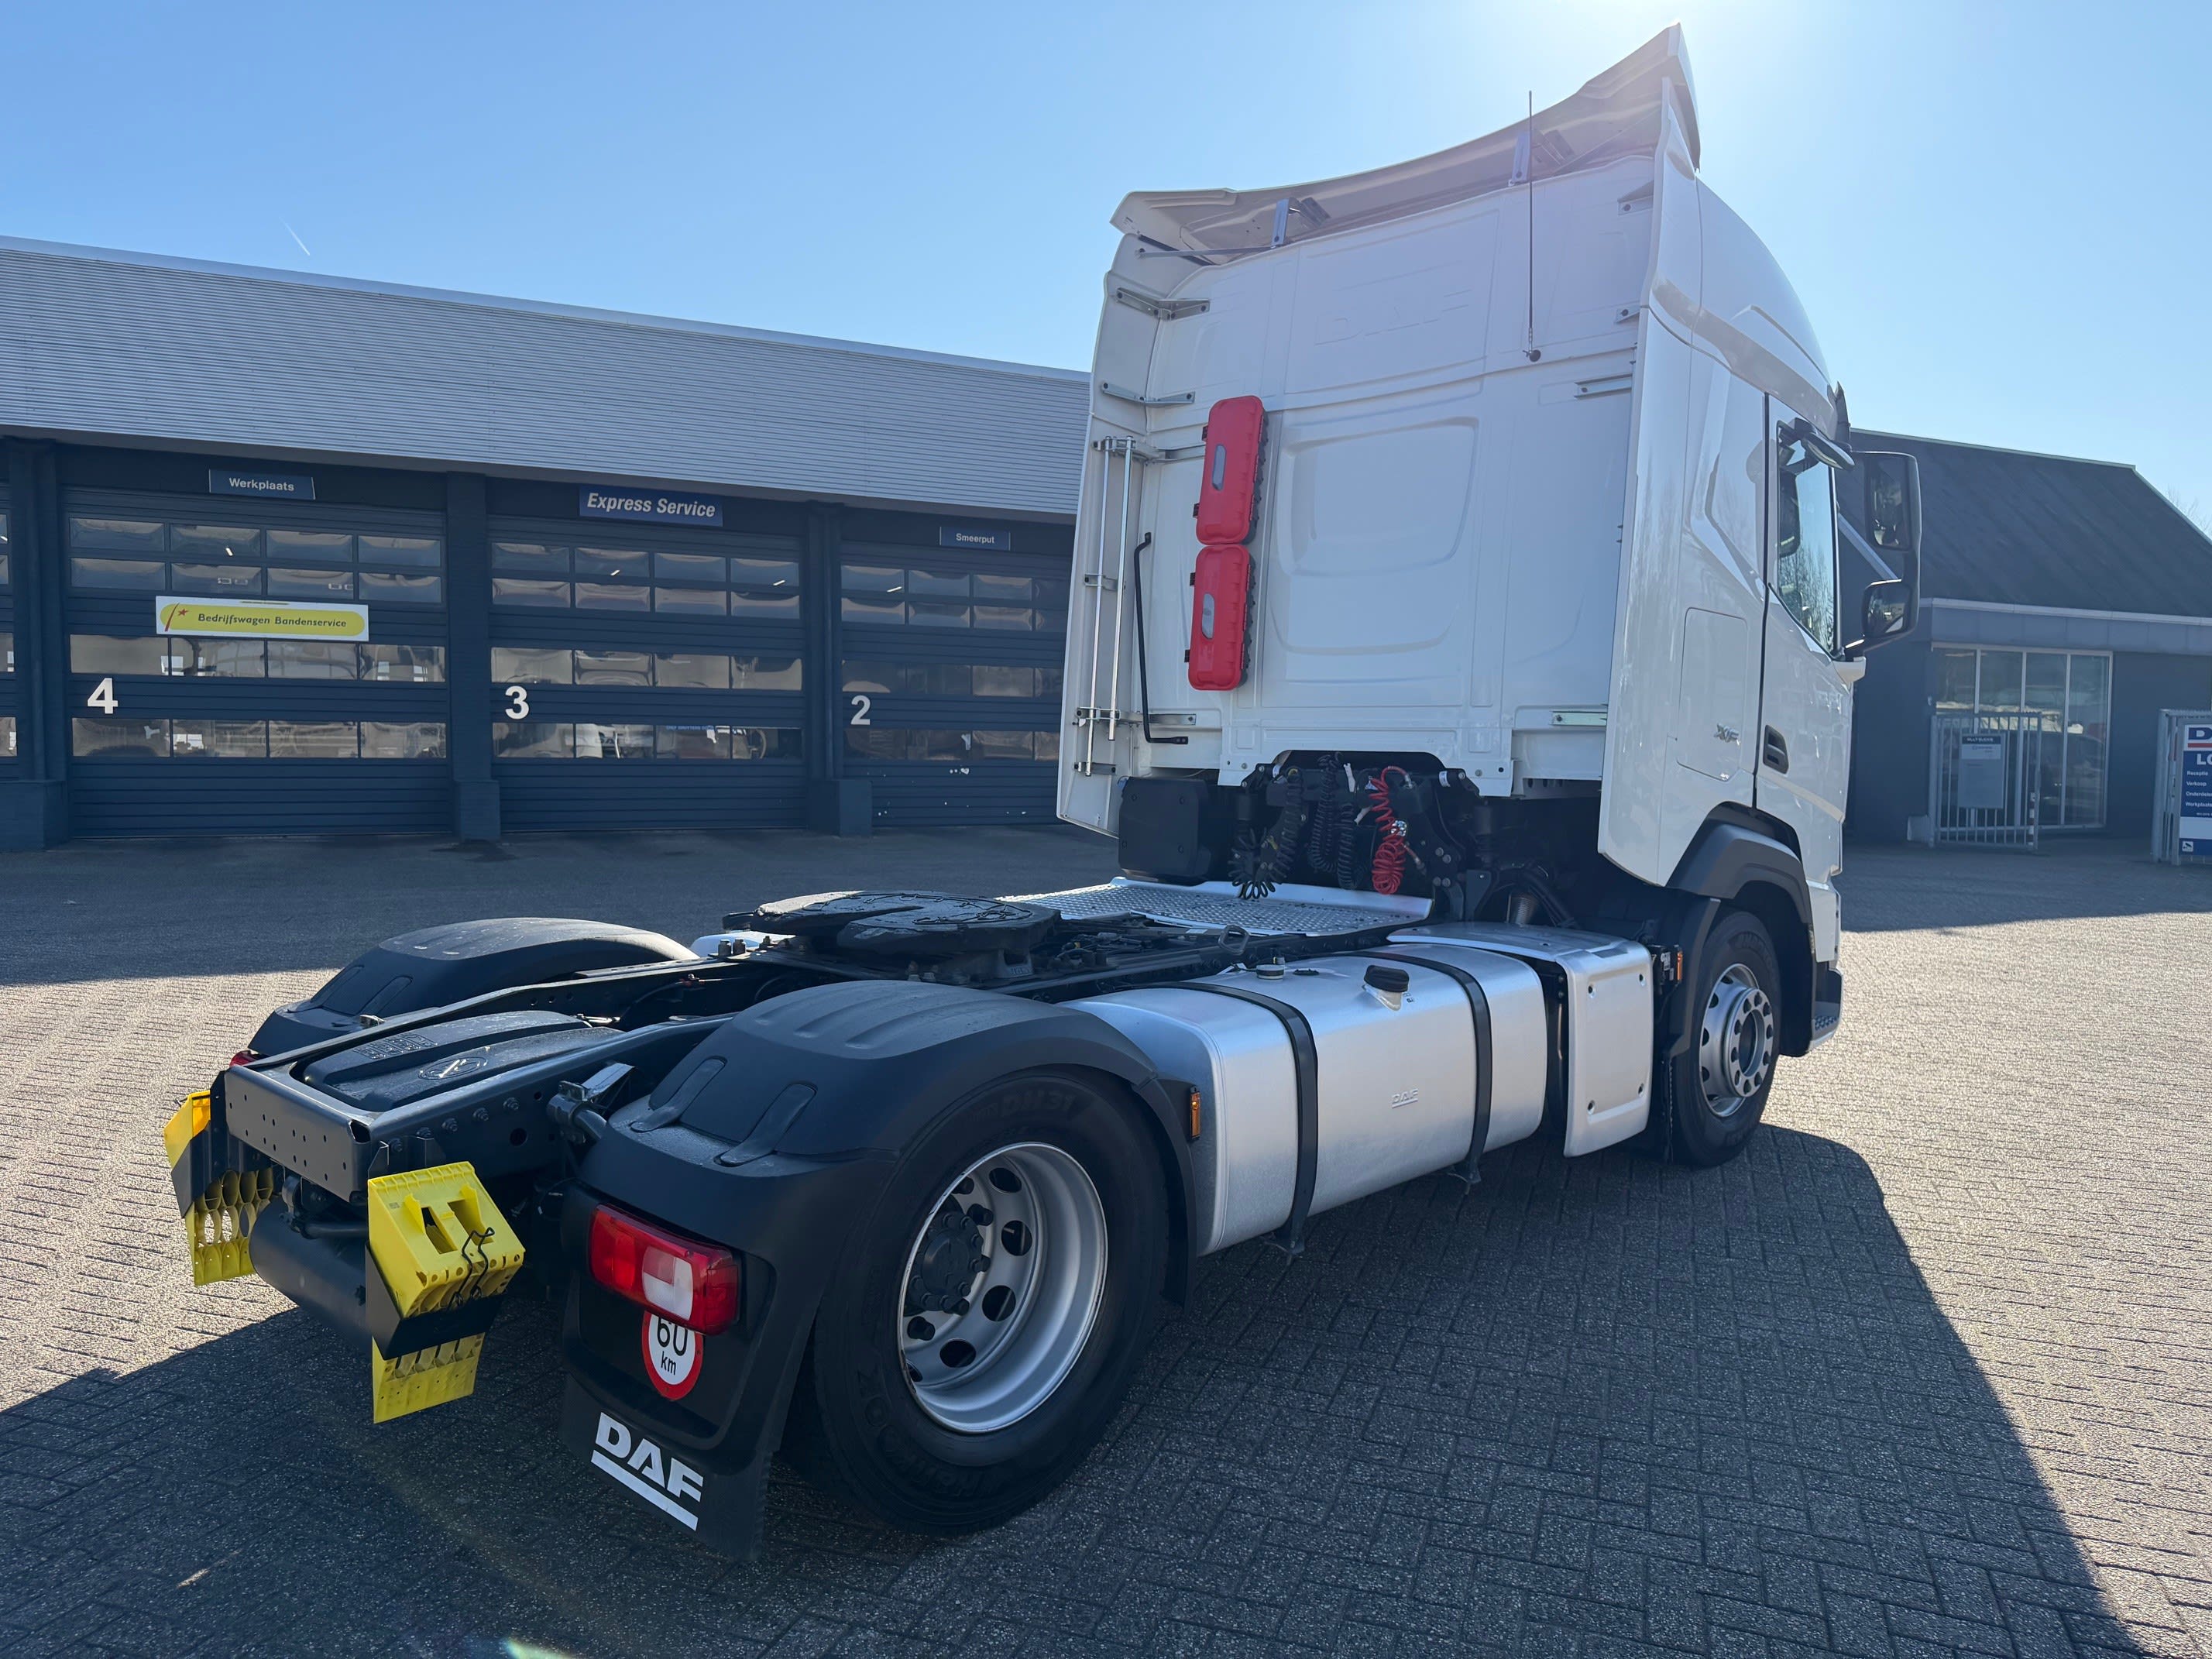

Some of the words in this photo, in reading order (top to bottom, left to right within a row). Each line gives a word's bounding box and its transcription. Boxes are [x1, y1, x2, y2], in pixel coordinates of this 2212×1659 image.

[228, 477, 295, 491] Werkplaats
[587, 493, 652, 513] Express
[656, 498, 716, 517] Service
[956, 533, 994, 544] Smeerput
[198, 613, 270, 625] Bedrijfswagen
[274, 617, 347, 627] Bandenservice
[87, 678, 118, 715] 4
[504, 685, 530, 720] 3
[850, 695, 871, 726] 2
[1391, 1088, 1418, 1104] DAF
[657, 1318, 688, 1356] 60
[661, 1351, 676, 1376] km
[595, 1412, 703, 1503] DAF
